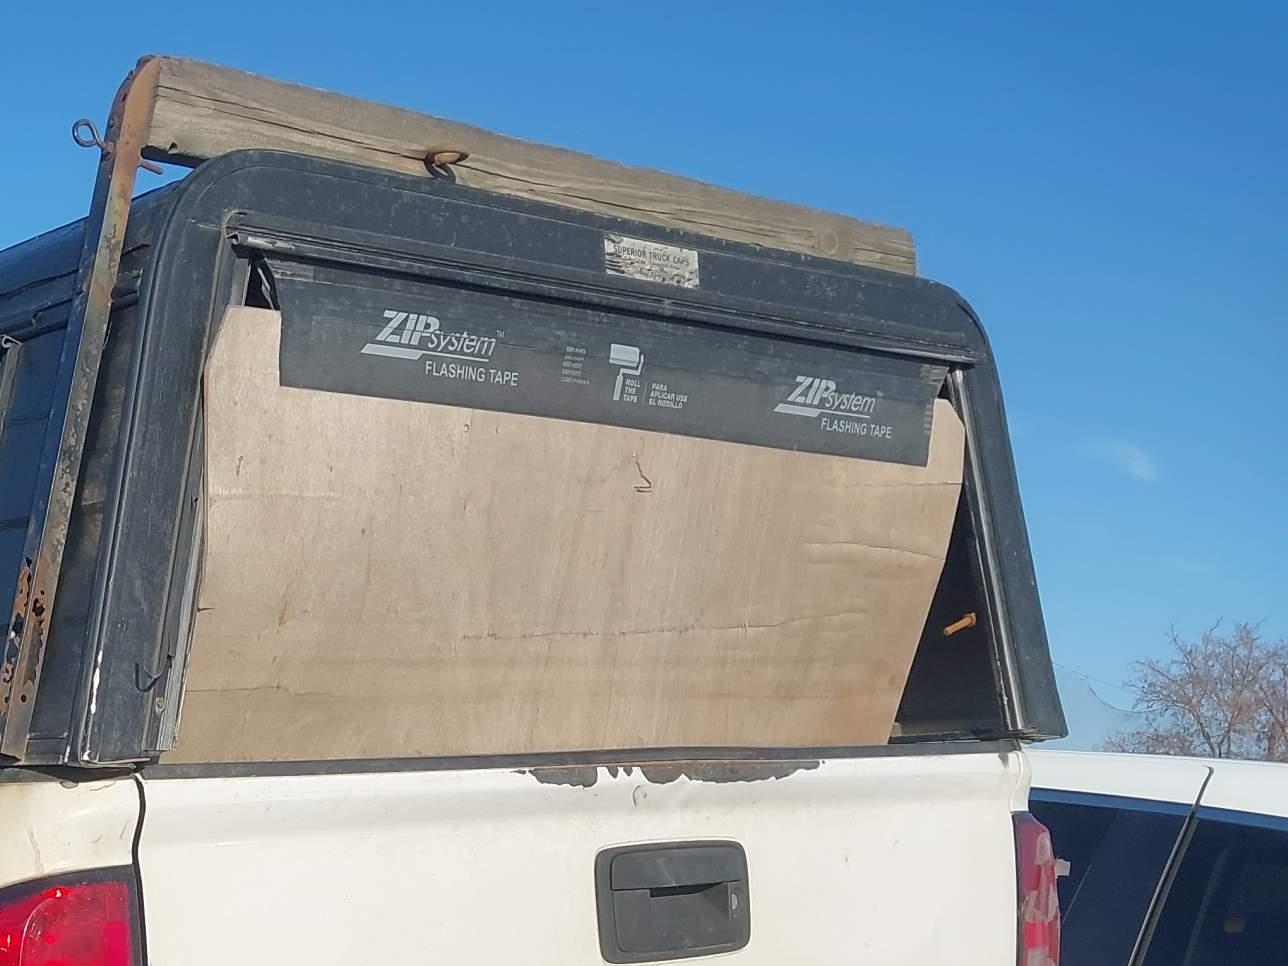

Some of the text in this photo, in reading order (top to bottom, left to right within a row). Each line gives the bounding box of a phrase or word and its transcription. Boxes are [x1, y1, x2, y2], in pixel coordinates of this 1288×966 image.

[613, 245, 690, 266] SUPERIOR TRUCK CAPS
[425, 361, 520, 387] FLASHING TAPE
[625, 378, 641, 388] ROLL
[652, 383, 668, 392] PARA
[624, 386, 638, 395] THE
[623, 394, 638, 403] TAPE
[820, 418, 893, 439] FLASHING TAPE
